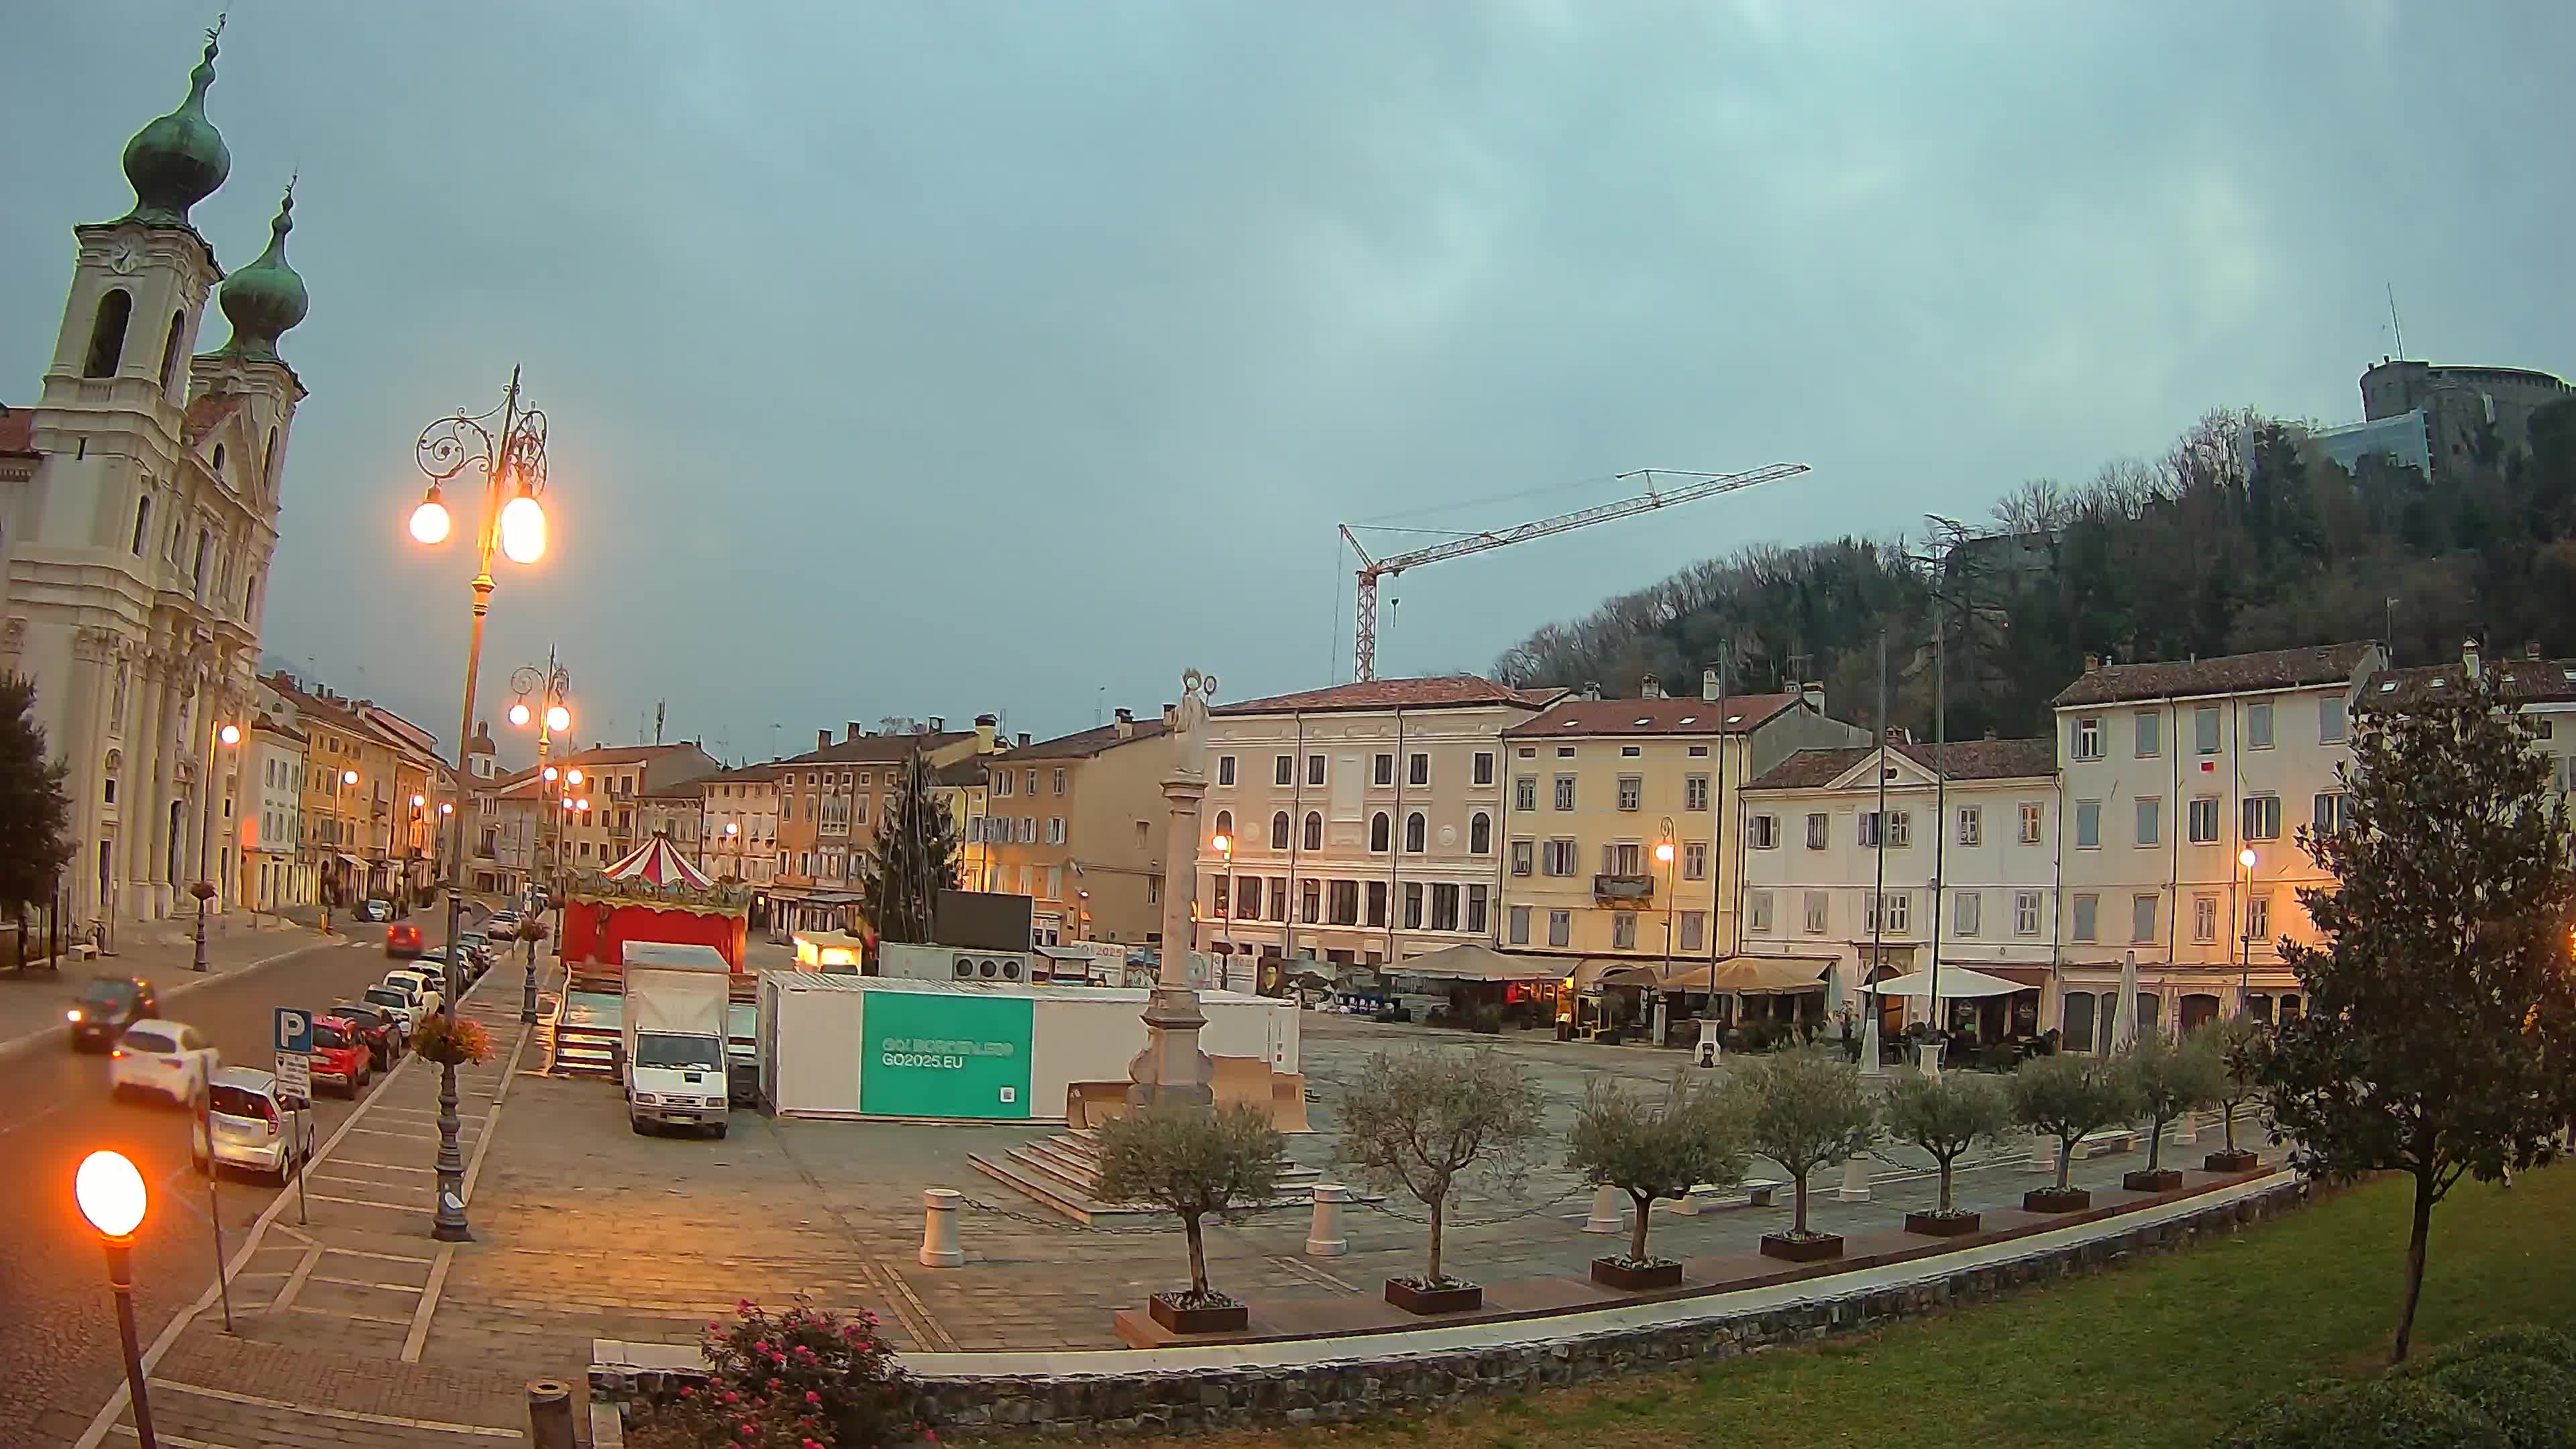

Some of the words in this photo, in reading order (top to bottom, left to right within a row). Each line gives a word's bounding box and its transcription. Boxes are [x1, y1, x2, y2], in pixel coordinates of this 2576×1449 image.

[1095, 947, 1122, 957] 2025
[280, 1011, 305, 1047] P
[882, 1053, 963, 1069] GO2025.EU
